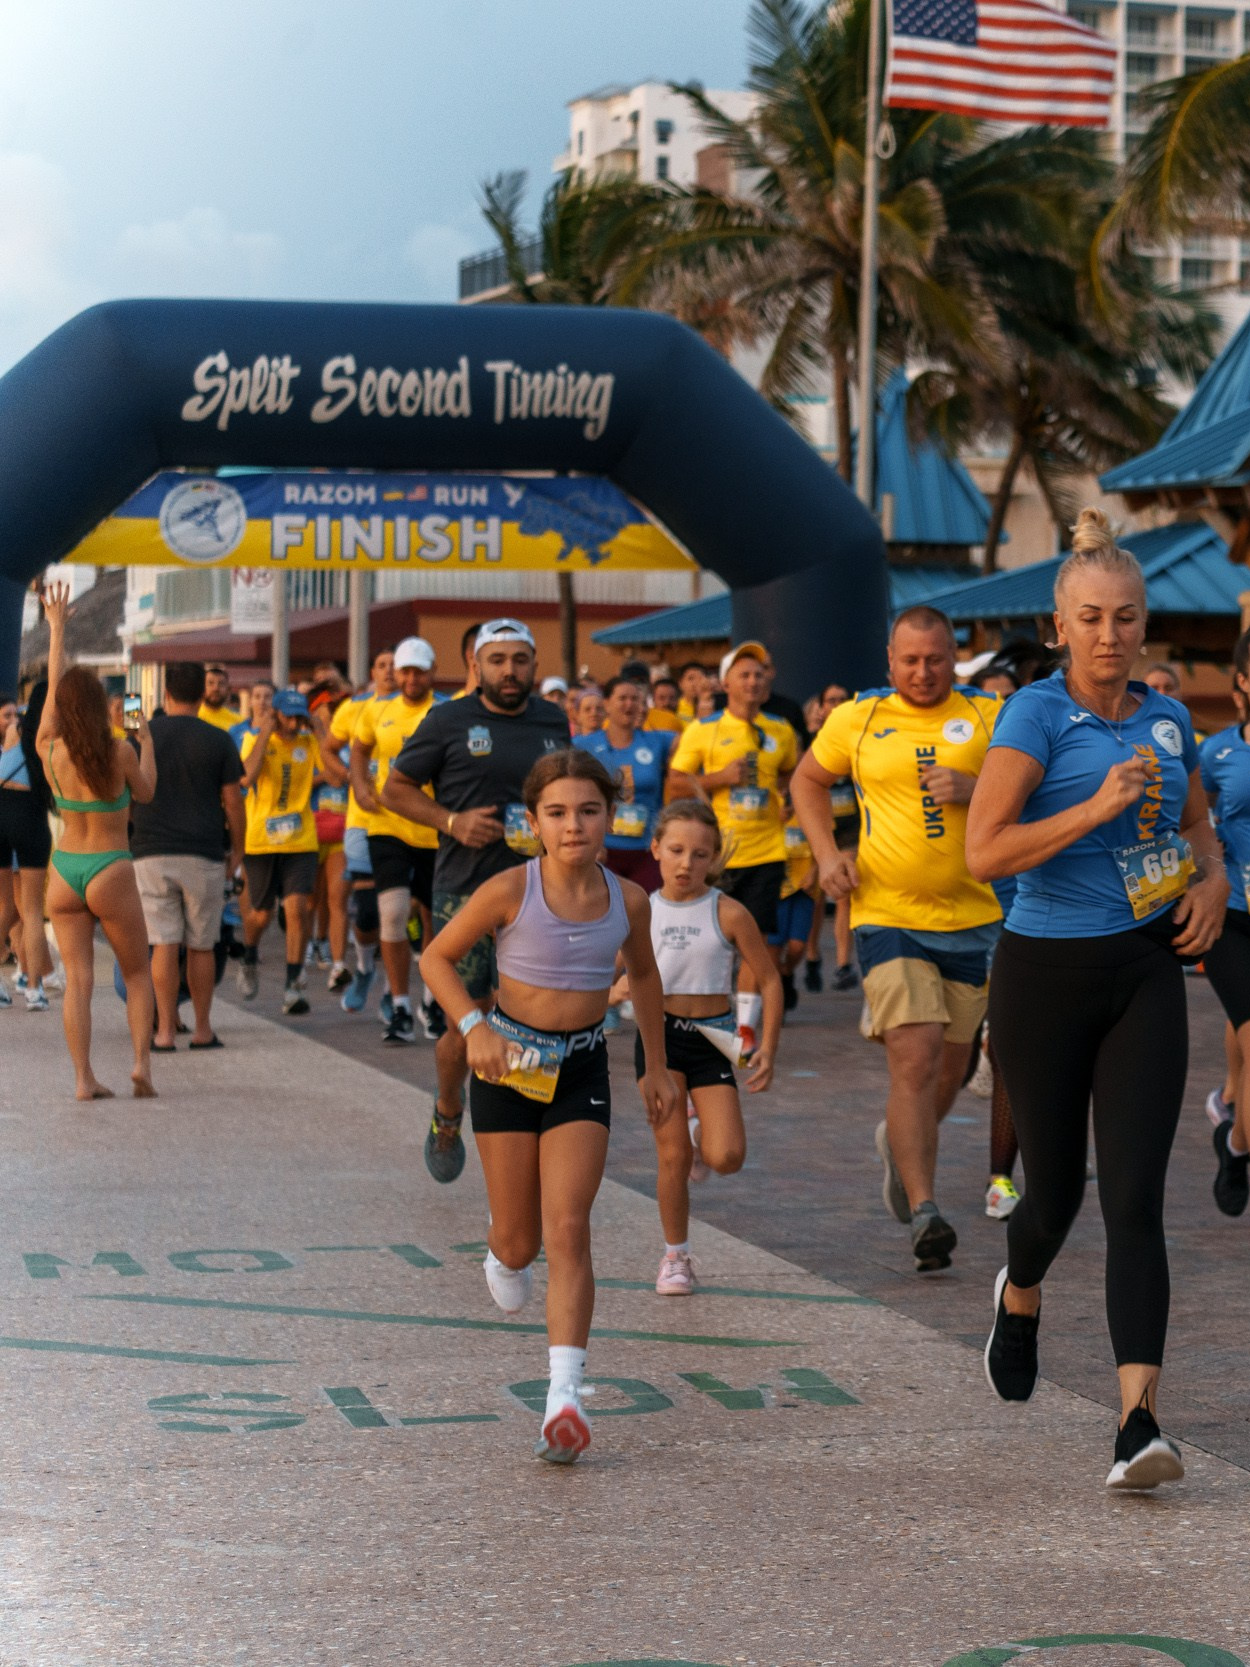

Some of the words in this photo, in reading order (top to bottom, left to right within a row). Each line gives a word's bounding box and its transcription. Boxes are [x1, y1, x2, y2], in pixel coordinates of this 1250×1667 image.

[181, 351, 300, 431] Split
[310, 354, 471, 423] Second
[484, 360, 615, 441] Timing
[284, 483, 376, 505] RAZOM
[434, 484, 488, 506] RUN
[270, 513, 501, 562] FINISH
[1133, 743, 1163, 840] KRANE
[1122, 841, 1155, 856] RAZOM
[1143, 847, 1180, 885] 69
[536, 1037, 557, 1047] RUN
